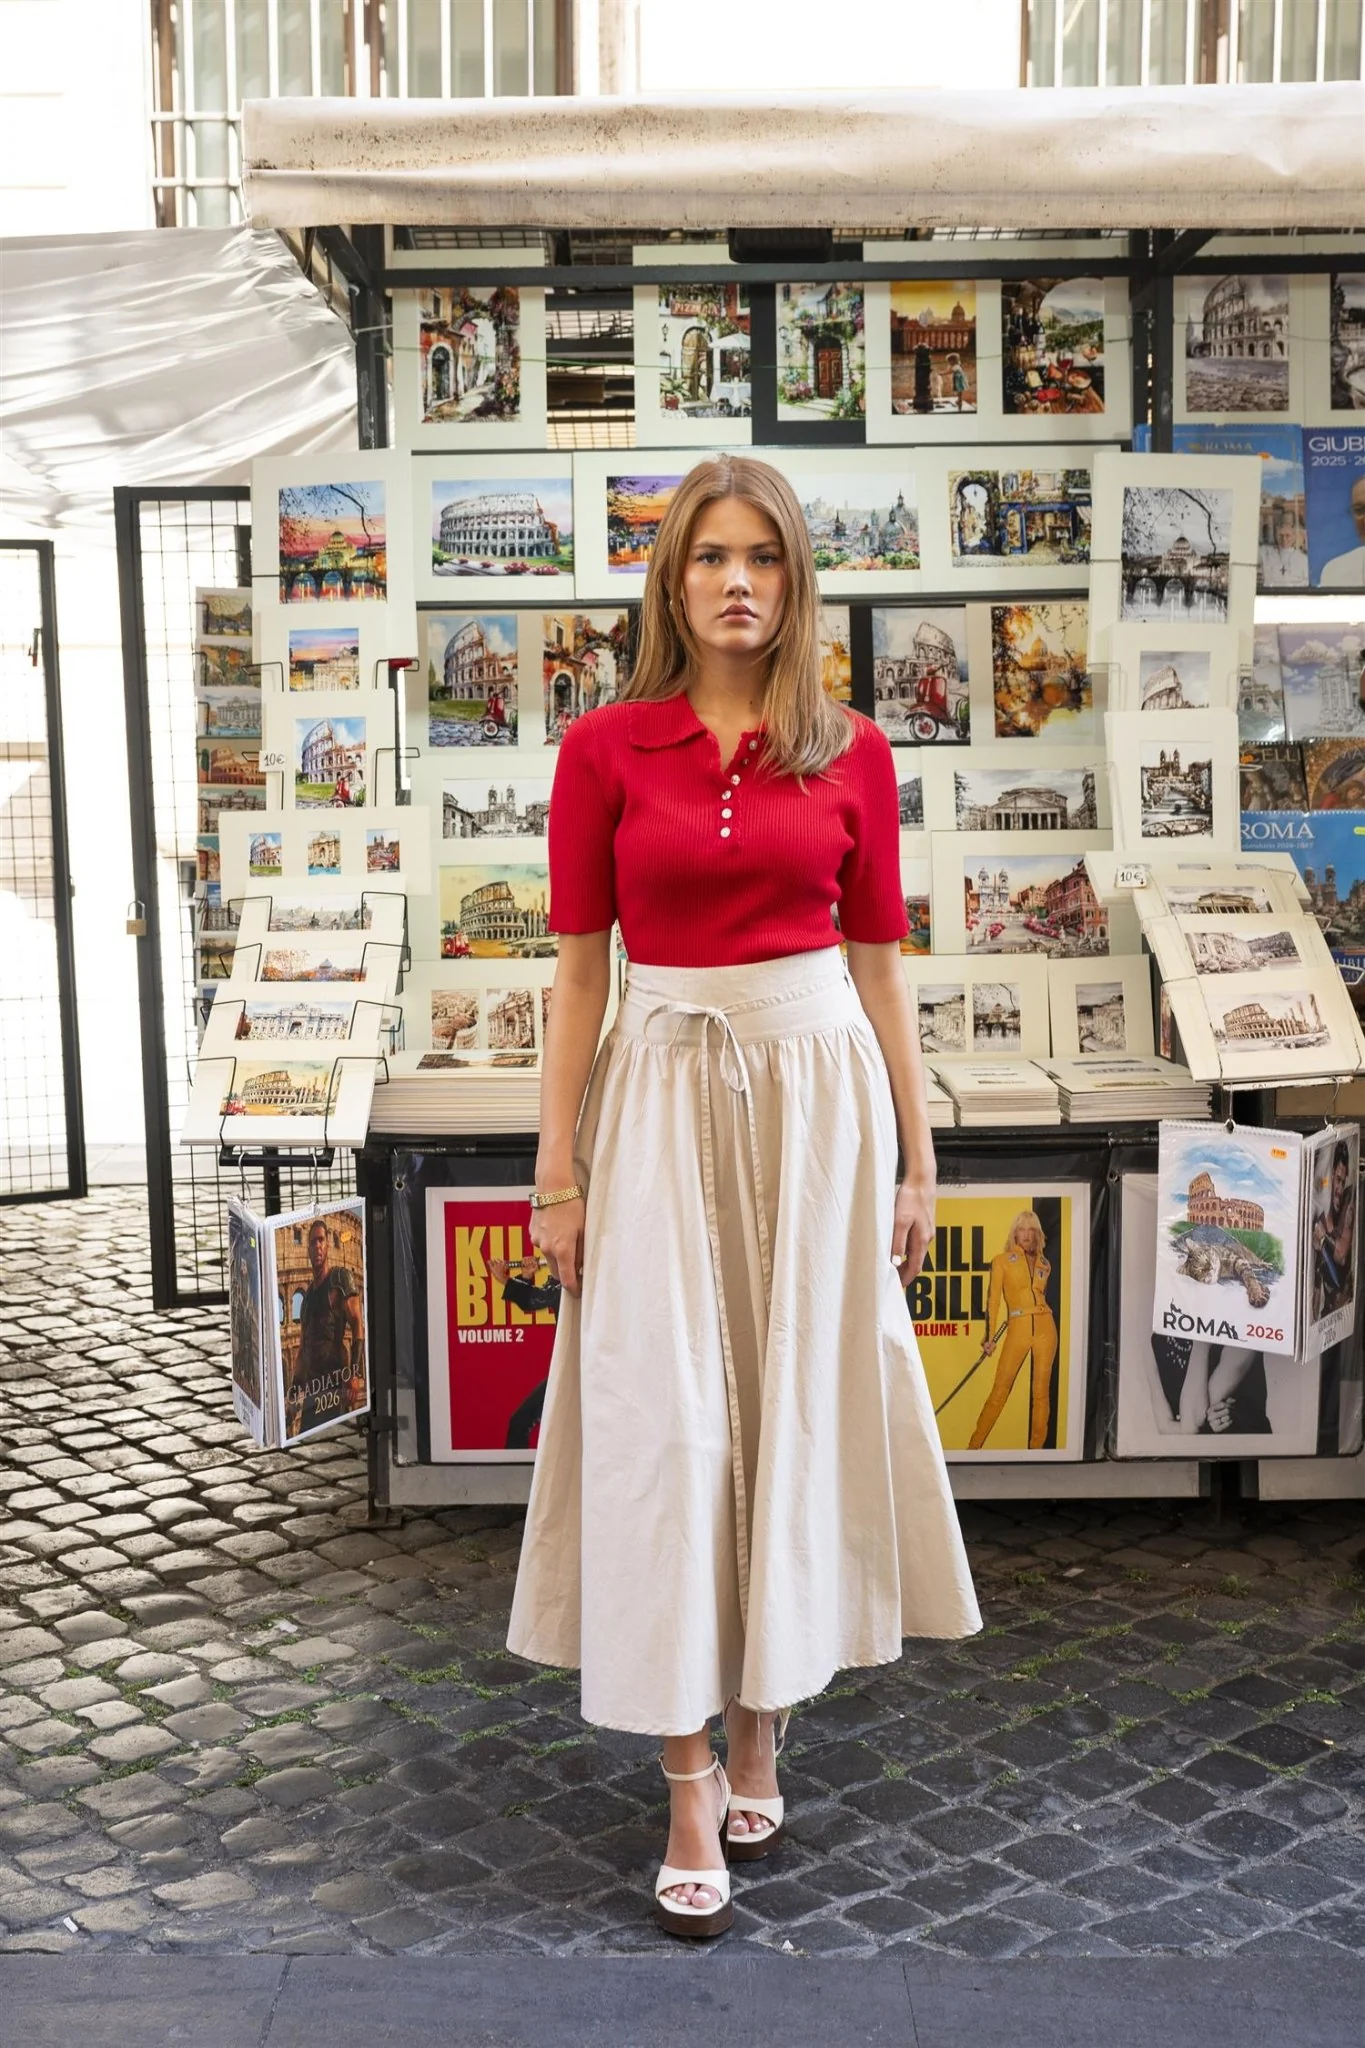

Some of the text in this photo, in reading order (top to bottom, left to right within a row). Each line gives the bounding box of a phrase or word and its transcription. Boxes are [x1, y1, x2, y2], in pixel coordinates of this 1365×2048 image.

[1308, 436, 1365, 452] GIUB
[1311, 455, 1347, 467] 2025
[905, 1275, 987, 1321] BILL
[457, 1328, 525, 1344] VOLUME 2
[914, 1322, 970, 1337] OLUME 1
[1163, 1311, 1285, 1342] ROMA 2026
[286, 1363, 362, 1406] GLADIATOR
[314, 1390, 340, 1415] 2026
